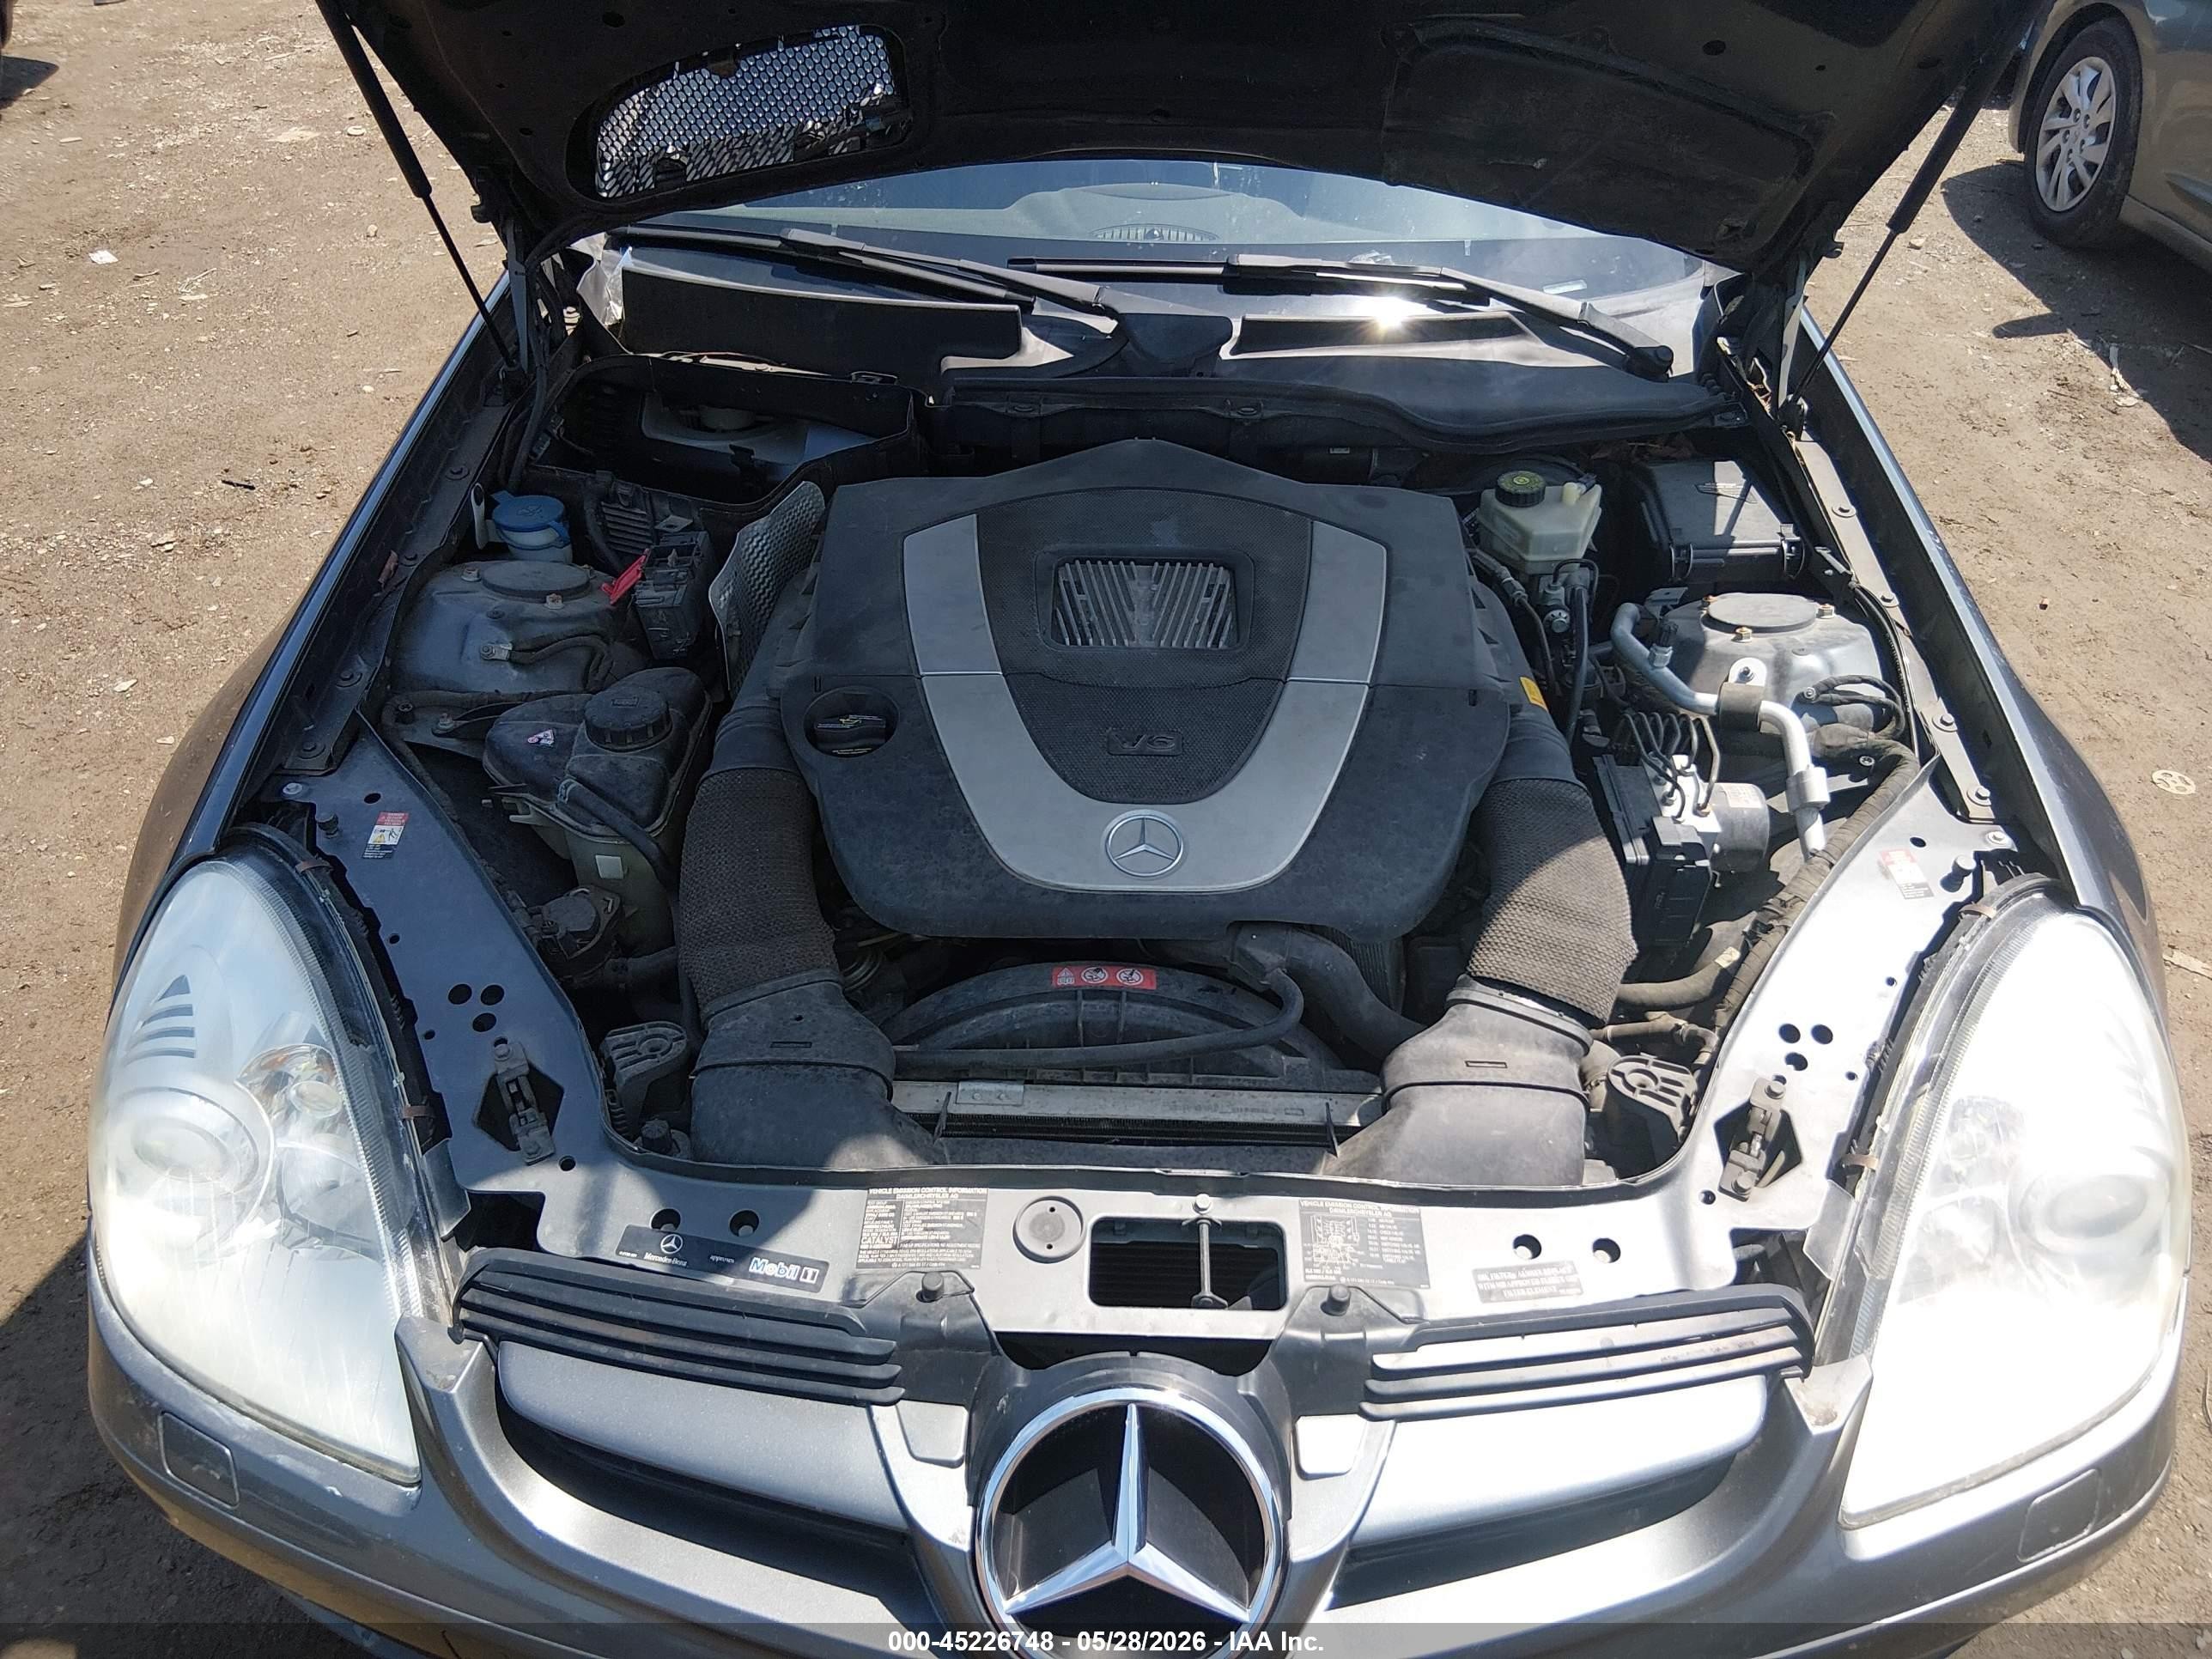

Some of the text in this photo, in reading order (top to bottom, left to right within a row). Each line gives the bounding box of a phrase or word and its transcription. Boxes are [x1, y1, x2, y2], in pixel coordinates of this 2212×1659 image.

[1115, 734, 1176, 750] V6
[861, 1236, 898, 1244] CATALYST
[643, 1252, 688, 1267] Mercedes-Benz
[749, 1257, 818, 1283] Mobil 1
